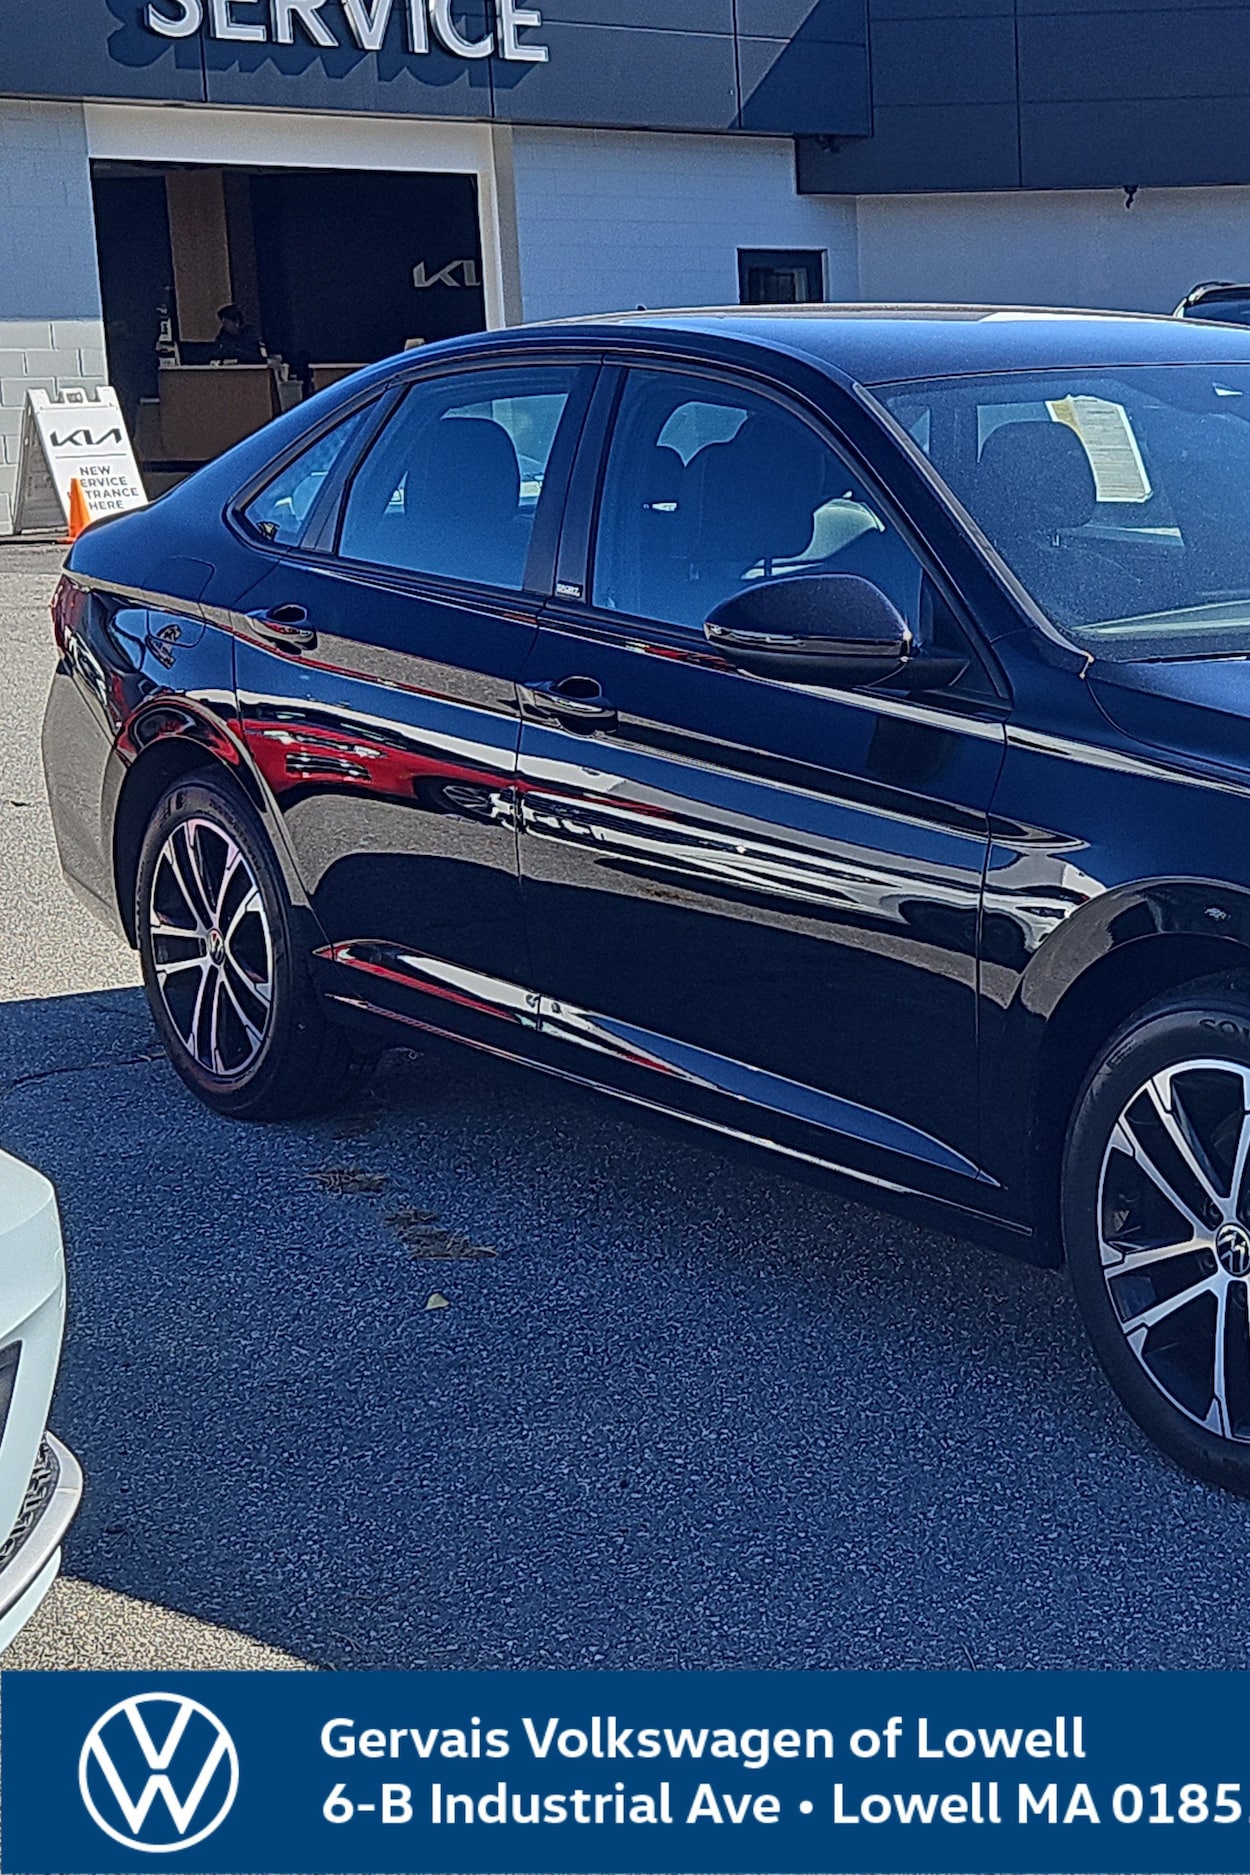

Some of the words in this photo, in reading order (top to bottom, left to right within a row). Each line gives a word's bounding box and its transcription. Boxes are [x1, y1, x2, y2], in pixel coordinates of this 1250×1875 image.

[413, 260, 481, 288] KI
[49, 428, 122, 447] KIA
[79, 465, 111, 476] NEW
[79, 476, 128, 488] ERVICE
[66, 487, 139, 502] TRANCE
[88, 500, 124, 511] HERE
